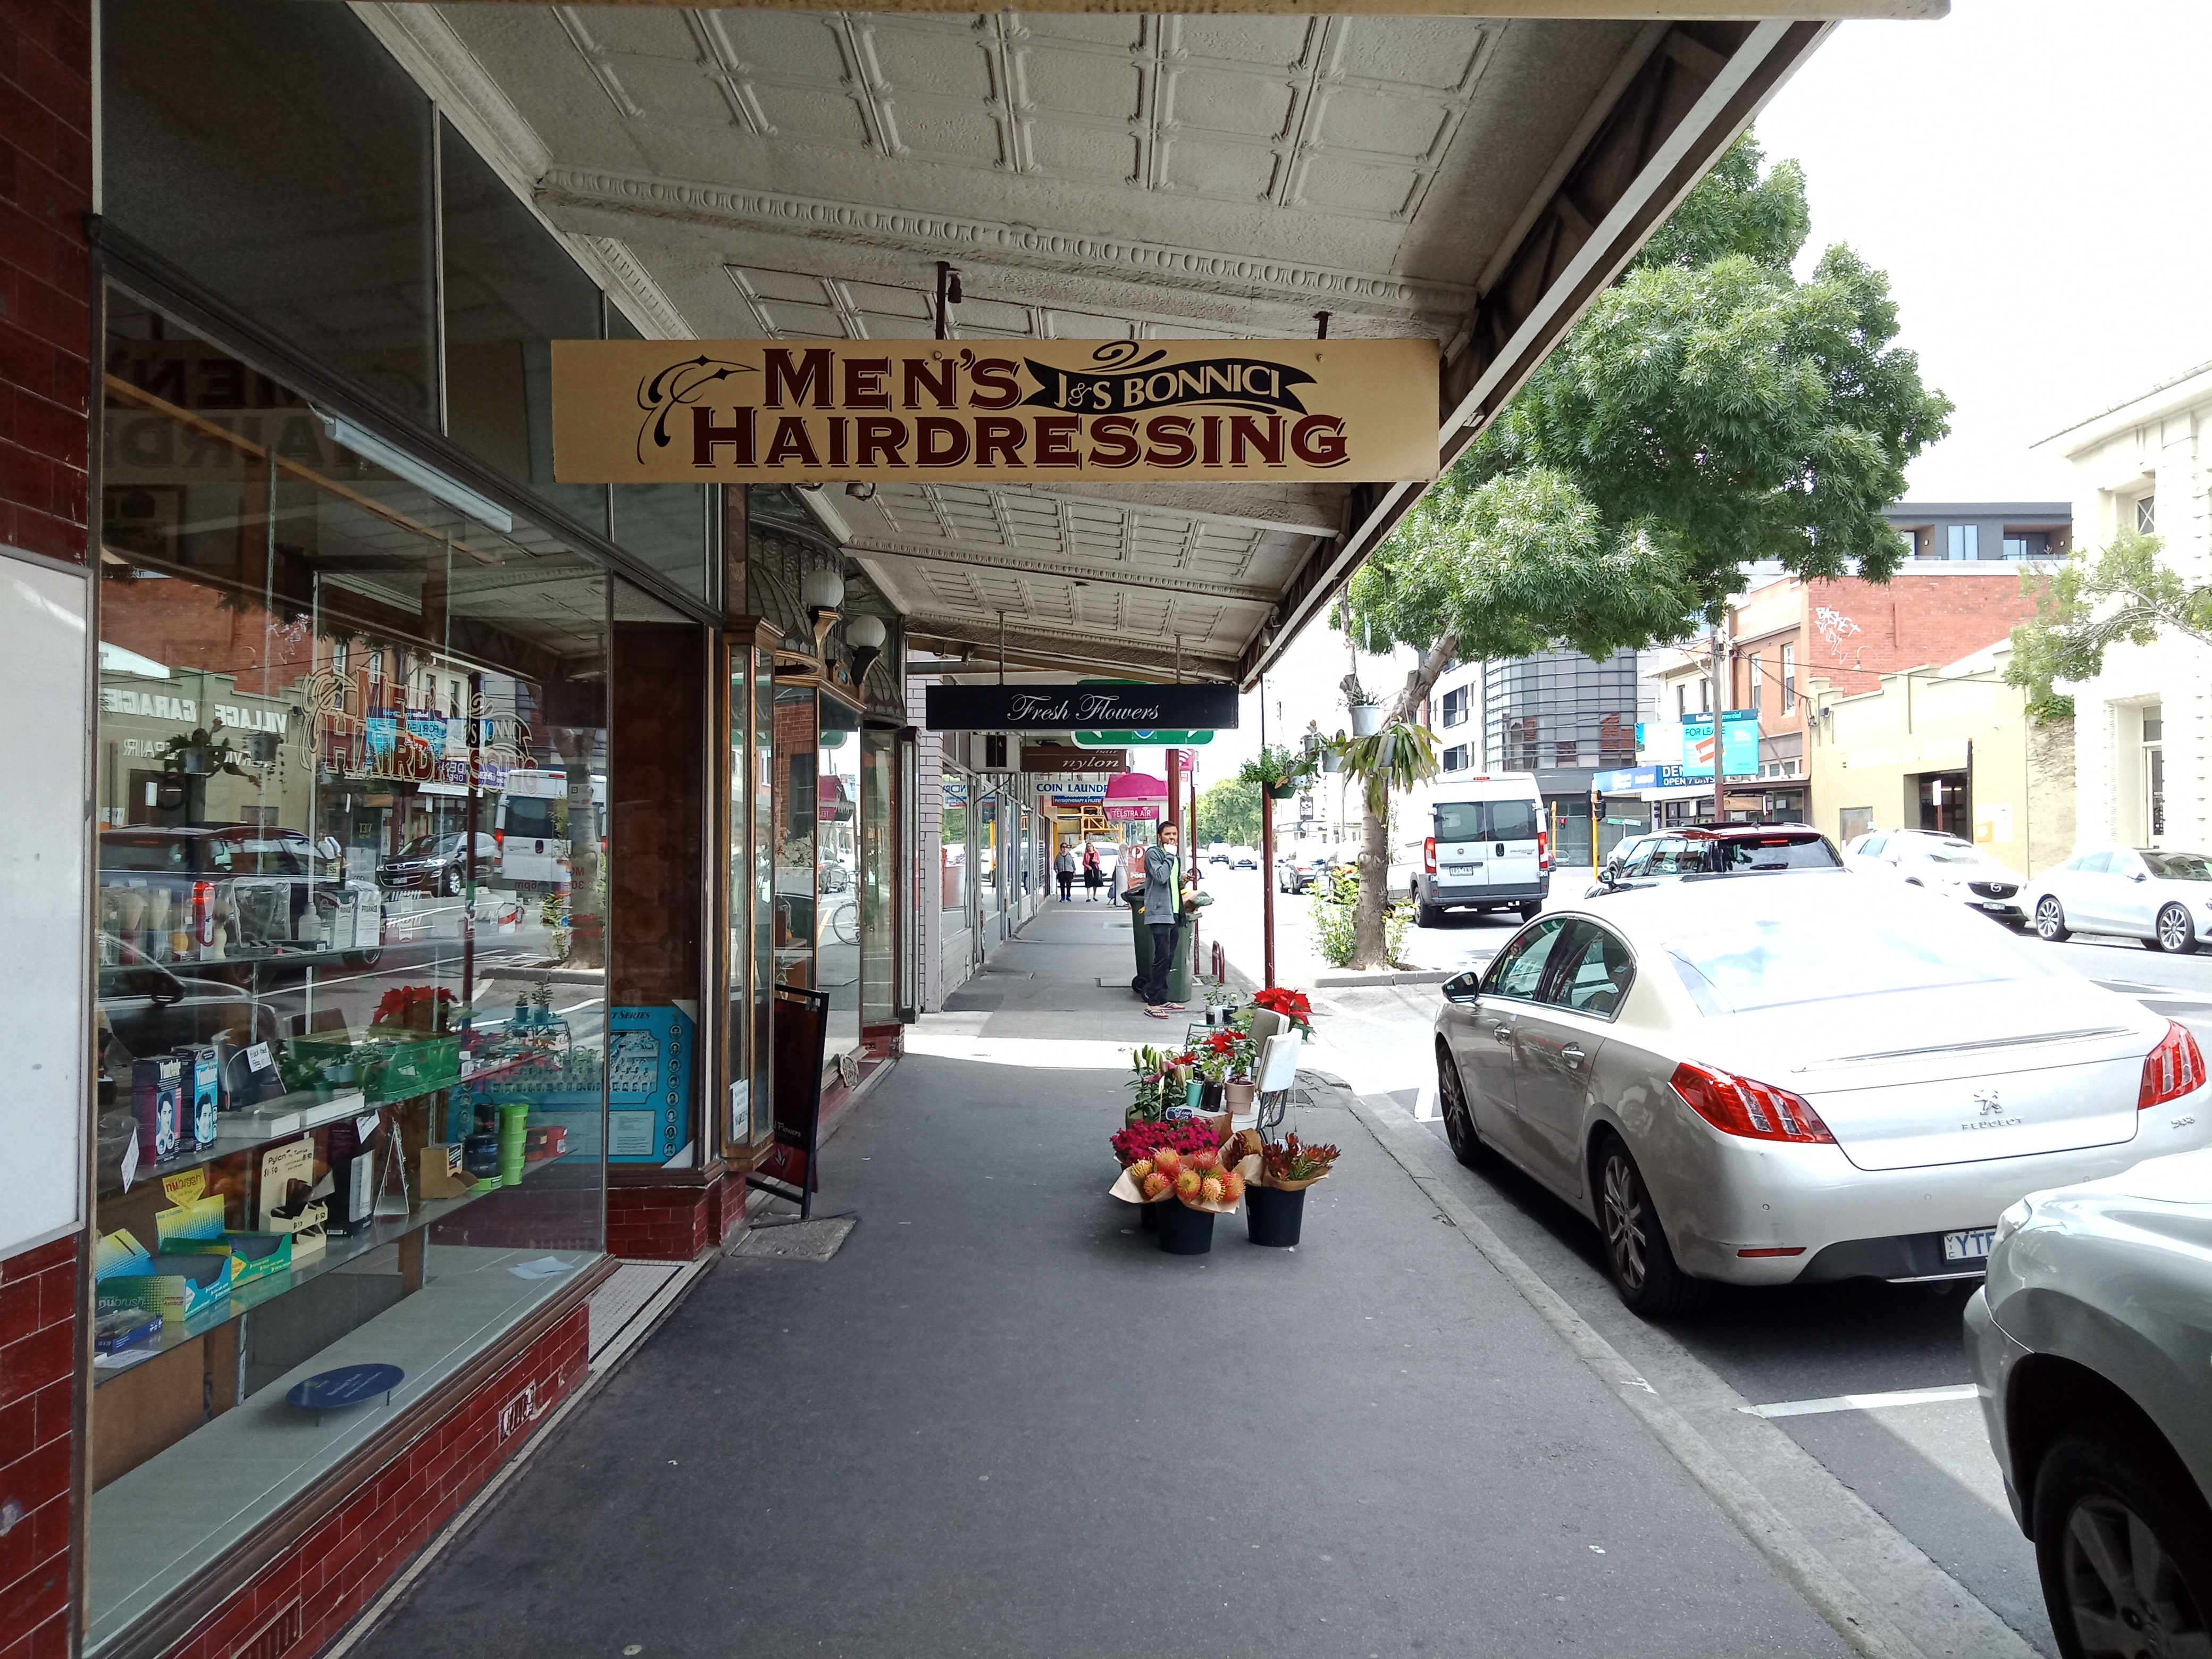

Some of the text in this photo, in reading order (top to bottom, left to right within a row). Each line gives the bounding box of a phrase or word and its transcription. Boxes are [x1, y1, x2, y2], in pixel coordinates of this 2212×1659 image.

[763, 348, 1022, 412] MEN'S
[1123, 364, 1279, 408] BONNICI
[691, 406, 1351, 471] HAIRDRESSING
[1007, 694, 1159, 721] Fresh Flowers
[1686, 728, 1701, 736] FOR
[1062, 756, 1119, 770] nylon
[1036, 783, 1109, 793] COIN LAUNDR
[1663, 777, 1686, 786] OPEN
[618, 1010, 650, 1019] SERIES
[777, 1121, 801, 1137] Flowers
[1961, 1116, 2024, 1130] PEUGEOT
